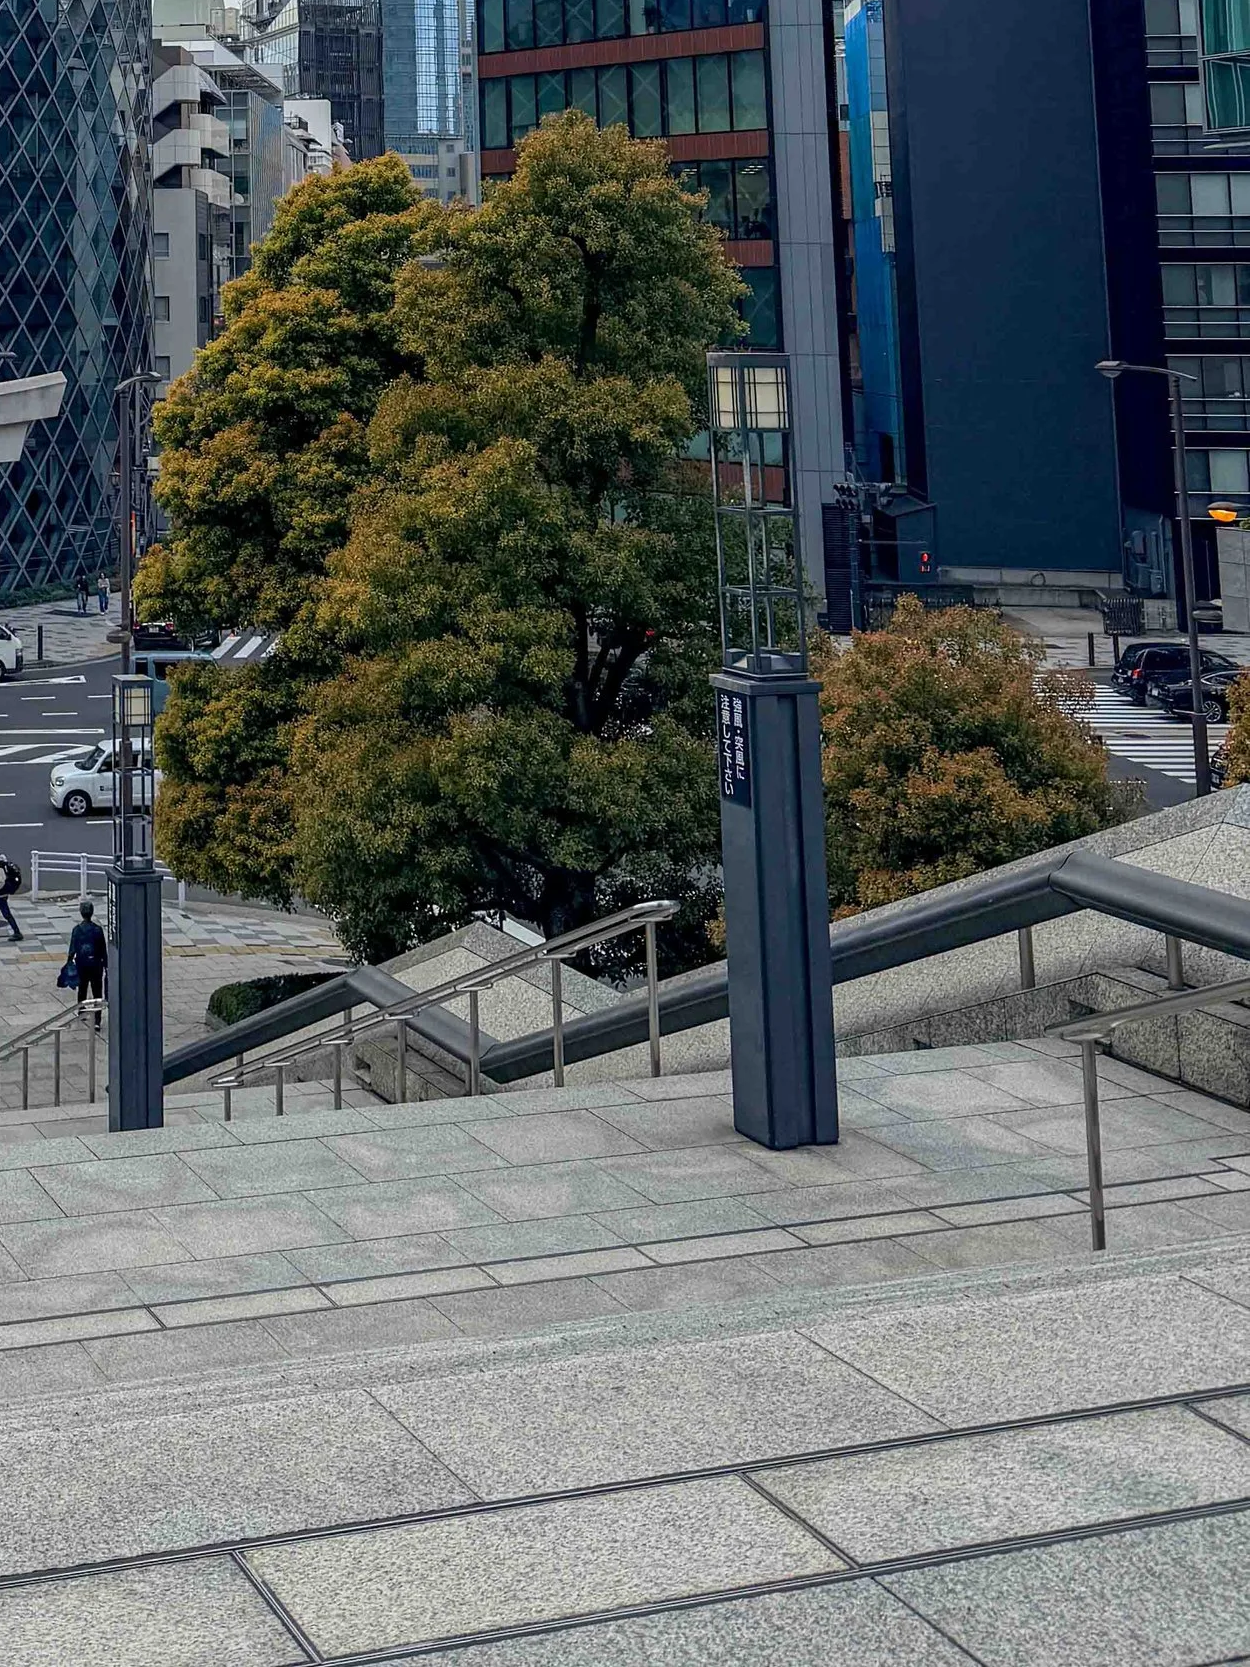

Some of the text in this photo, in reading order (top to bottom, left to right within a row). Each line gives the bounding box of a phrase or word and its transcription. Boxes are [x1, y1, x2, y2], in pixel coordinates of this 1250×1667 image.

[720, 694, 734, 795] 注意して下さい
